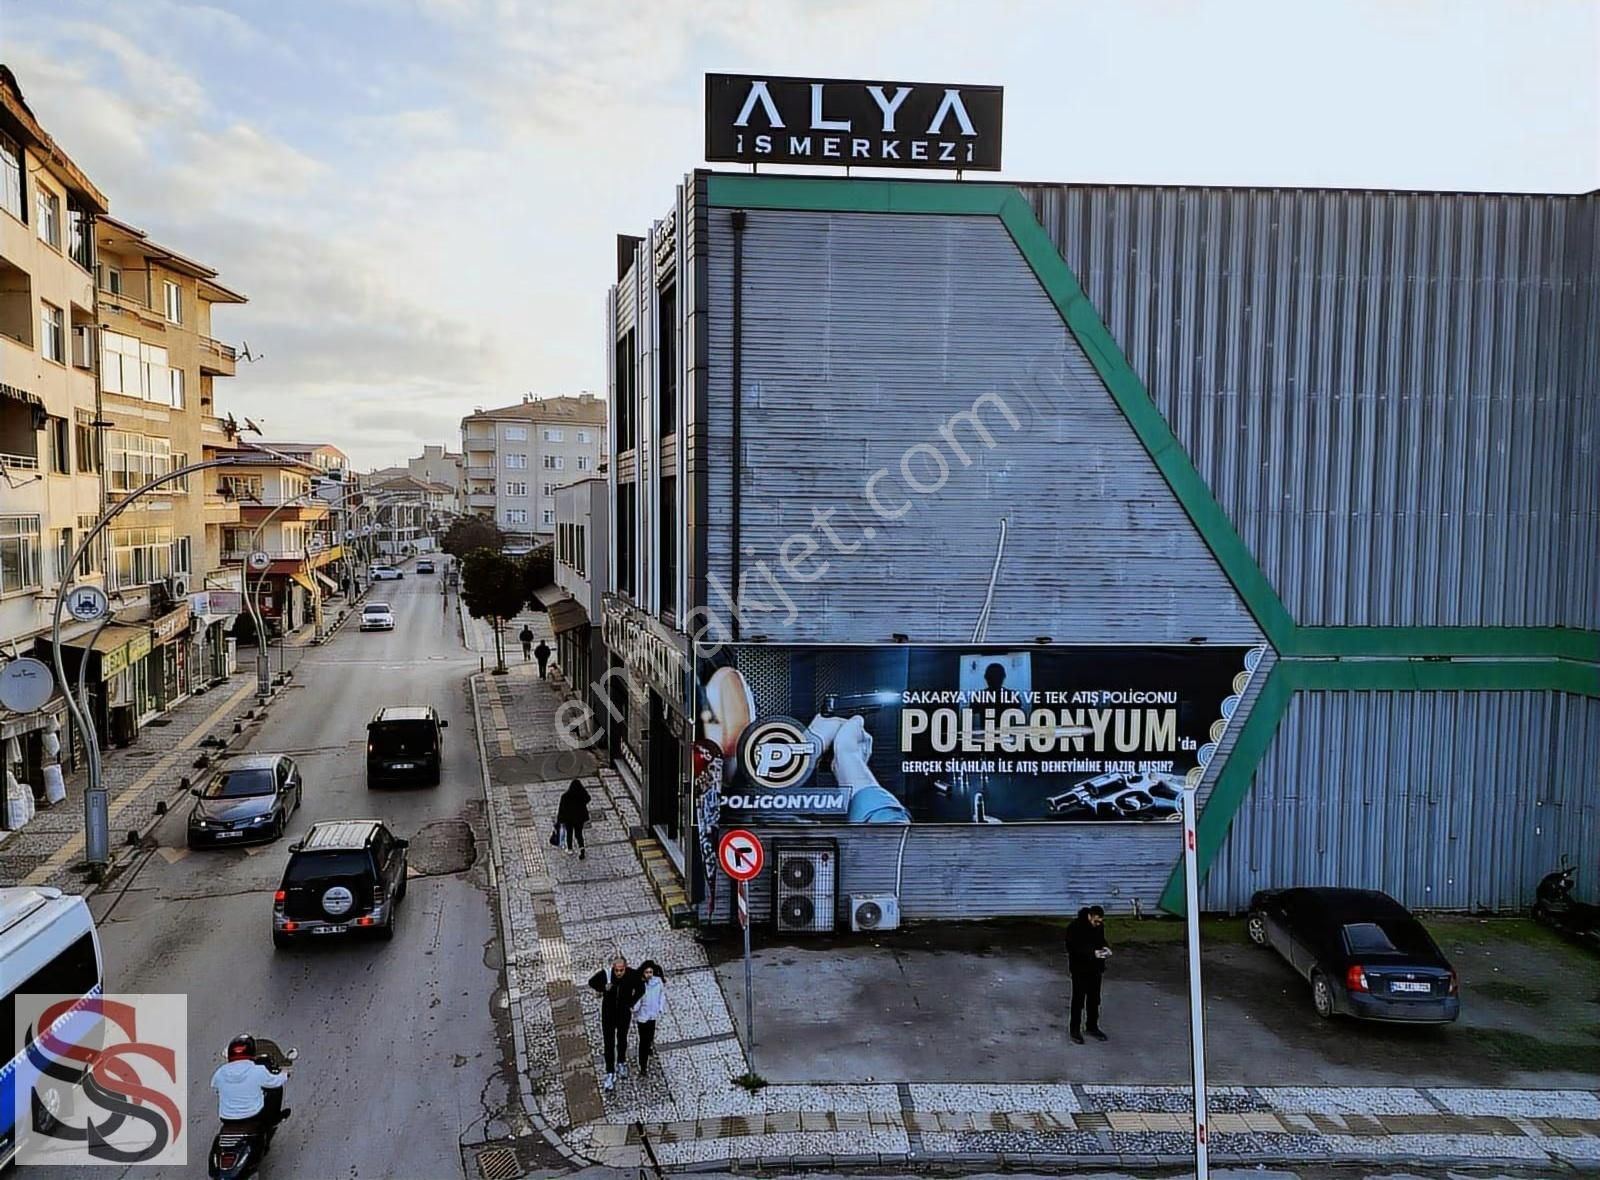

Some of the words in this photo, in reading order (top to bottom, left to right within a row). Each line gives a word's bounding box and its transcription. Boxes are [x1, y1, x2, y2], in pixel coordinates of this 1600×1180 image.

[733, 80, 978, 136] ALYA
[902, 690, 996, 704] SAKARYA'NIN
[1000, 688, 1020, 704] İLK
[1023, 690, 1042, 704] VE
[1045, 691, 1068, 704] TEK
[1071, 691, 1099, 706] ATIŞ
[1103, 688, 1177, 704] POLİGONU
[902, 760, 942, 776] GERÇEK
[998, 758, 1013, 773] İLE
[1016, 760, 1039, 776] ATIŞ
[1104, 760, 1135, 774] HAZIR
